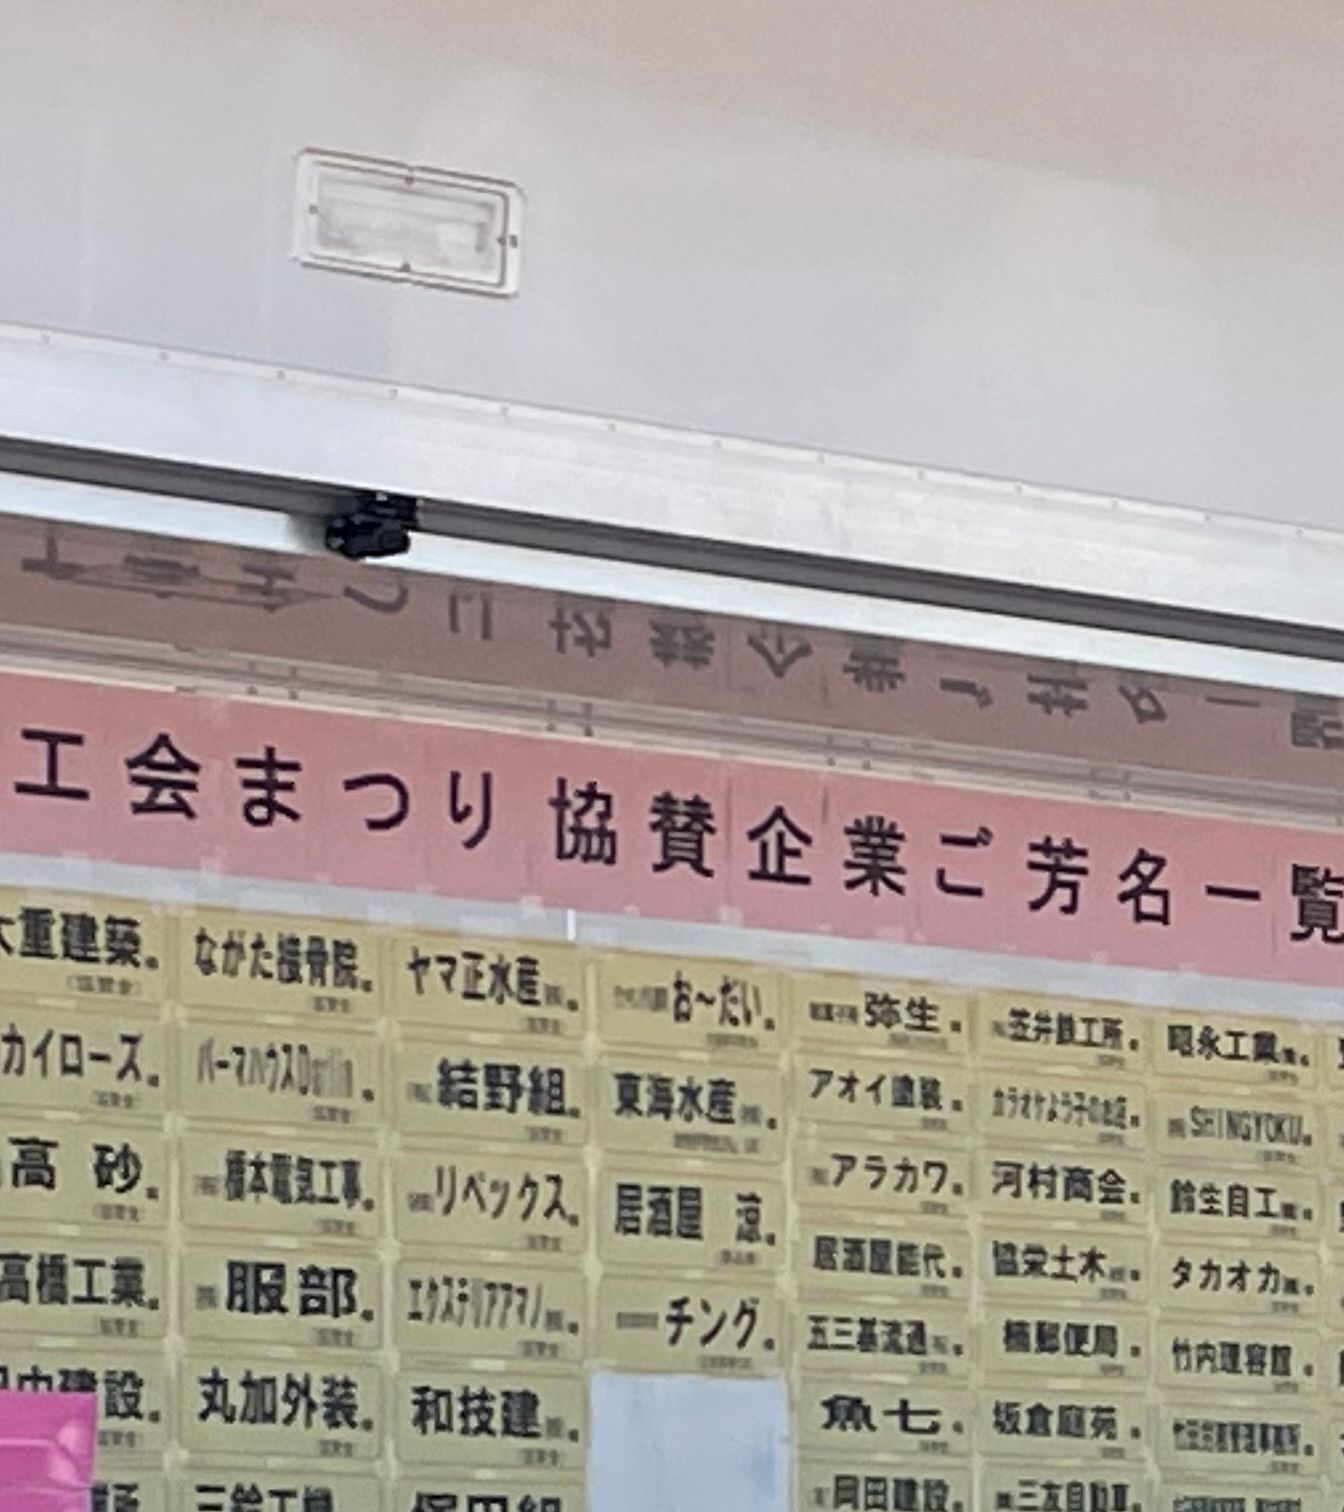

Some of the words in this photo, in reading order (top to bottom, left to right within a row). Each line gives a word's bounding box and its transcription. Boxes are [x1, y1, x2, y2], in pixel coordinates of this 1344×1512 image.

[831, 1154, 948, 1193] アラカワ
[1173, 1257, 1280, 1294] タカオカ
